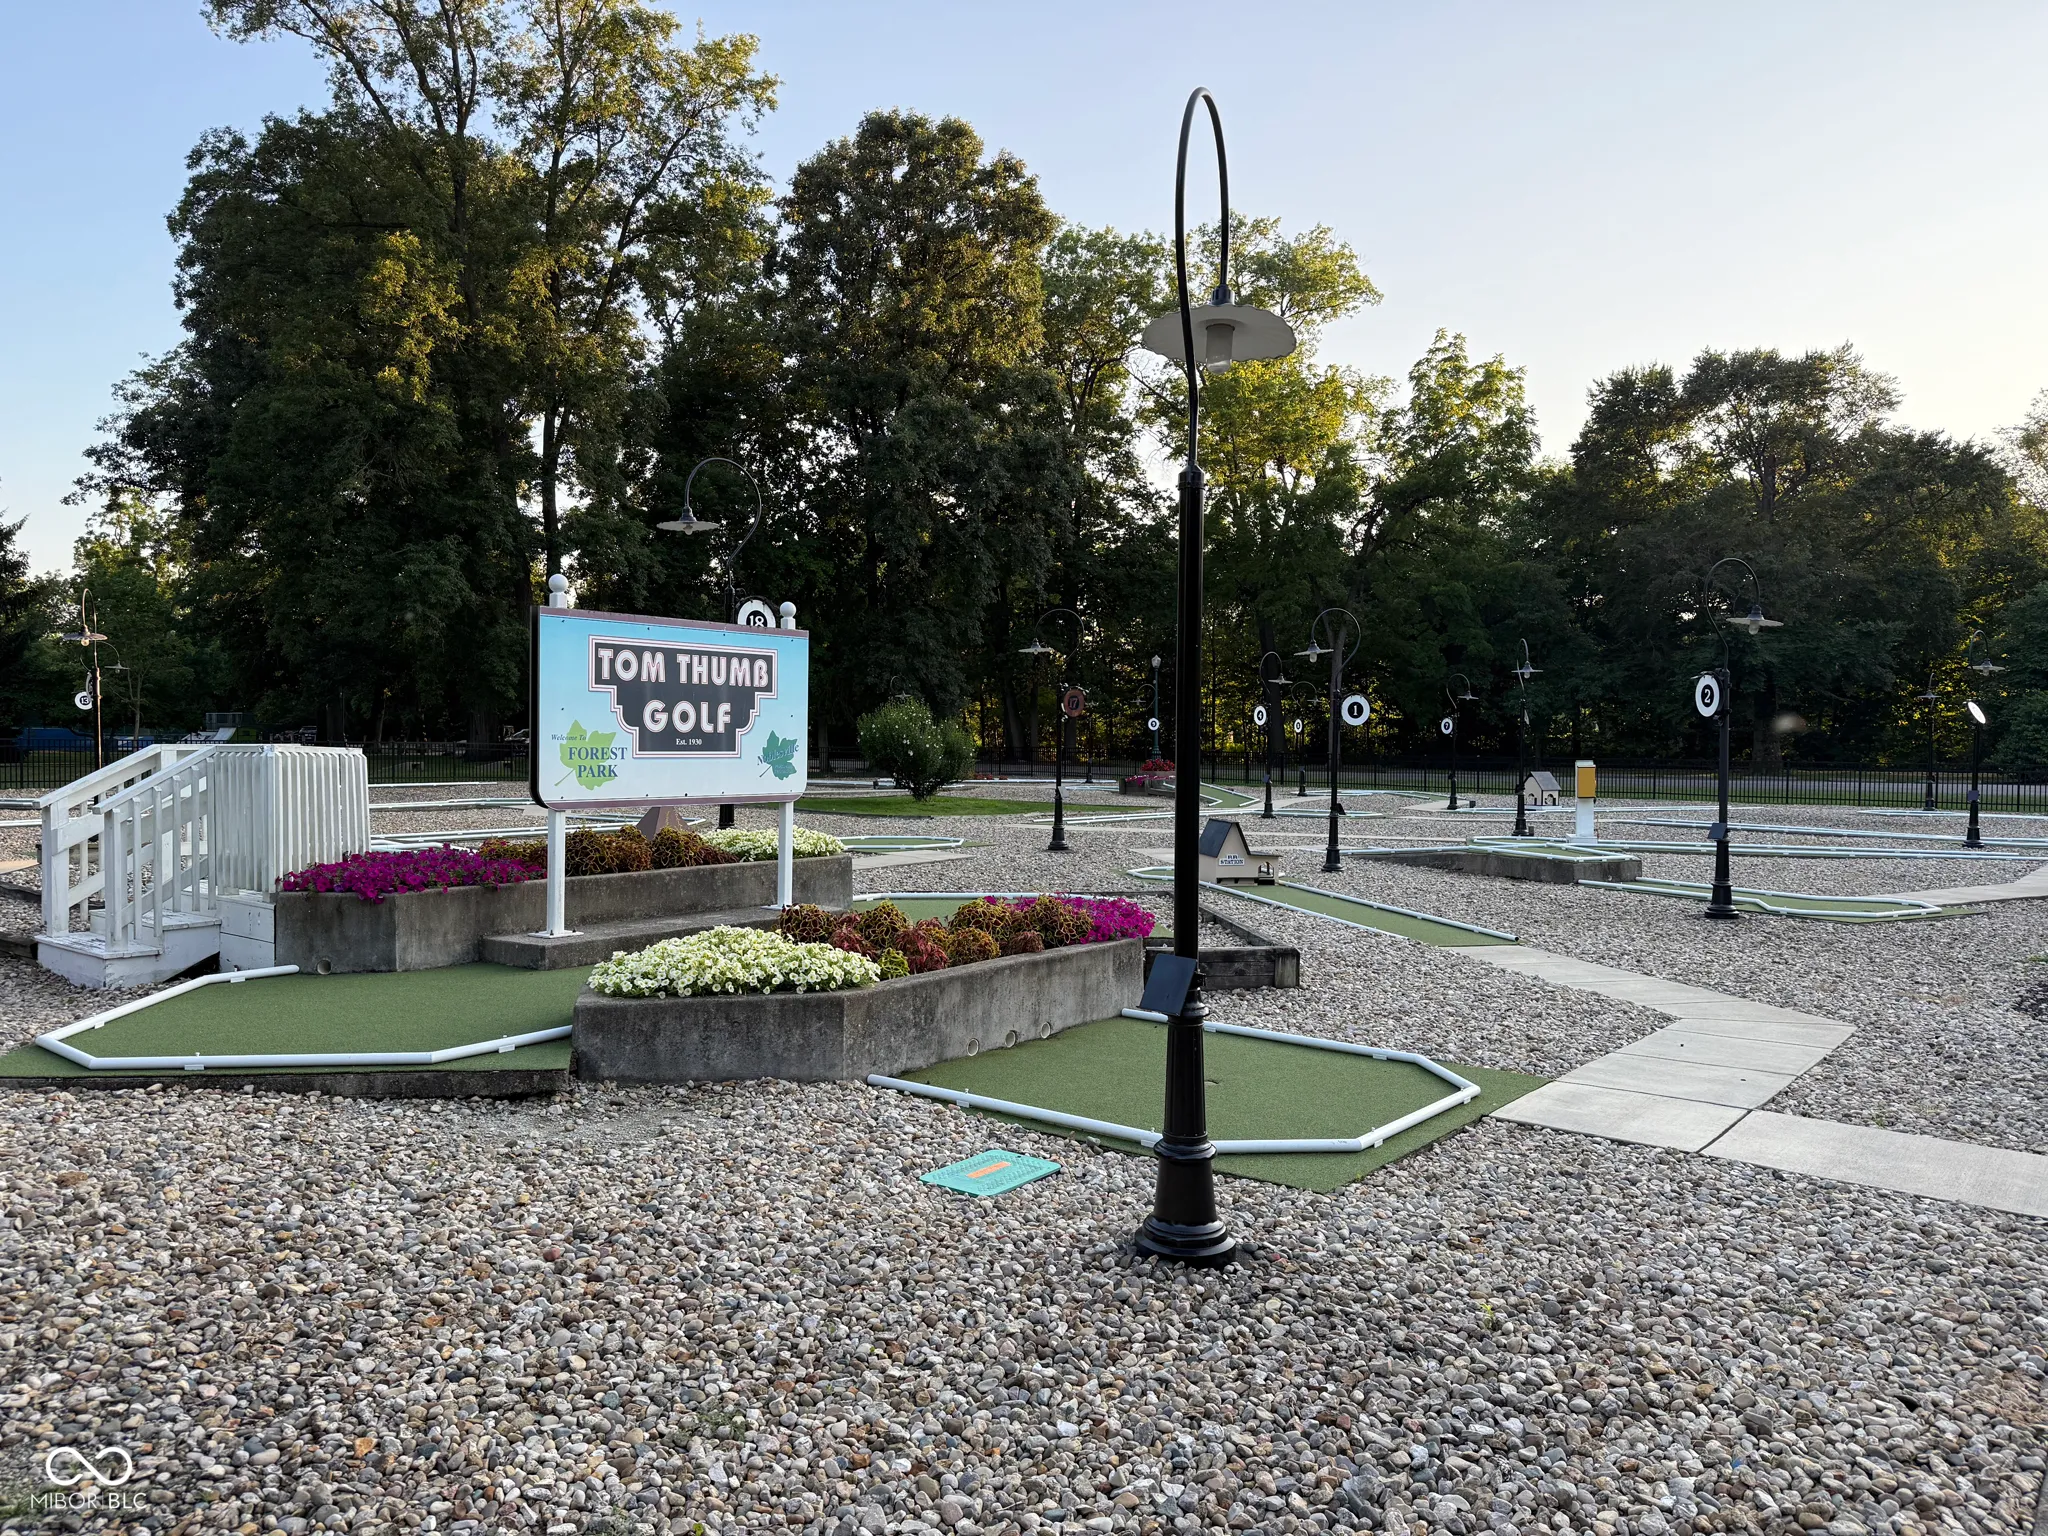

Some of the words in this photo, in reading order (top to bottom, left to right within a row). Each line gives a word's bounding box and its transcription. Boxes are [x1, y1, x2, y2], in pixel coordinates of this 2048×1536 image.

[749, 615, 765, 627] 18
[597, 647, 666, 683] TOM
[676, 653, 769, 688] THUMB
[1704, 688, 1711, 703] 2
[642, 699, 732, 734] GOLF
[1353, 704, 1358, 716] 1
[676, 738, 688, 746] Est.
[688, 738, 703, 746] 1930
[568, 746, 628, 761] FOREST
[577, 764, 619, 778] PARK
